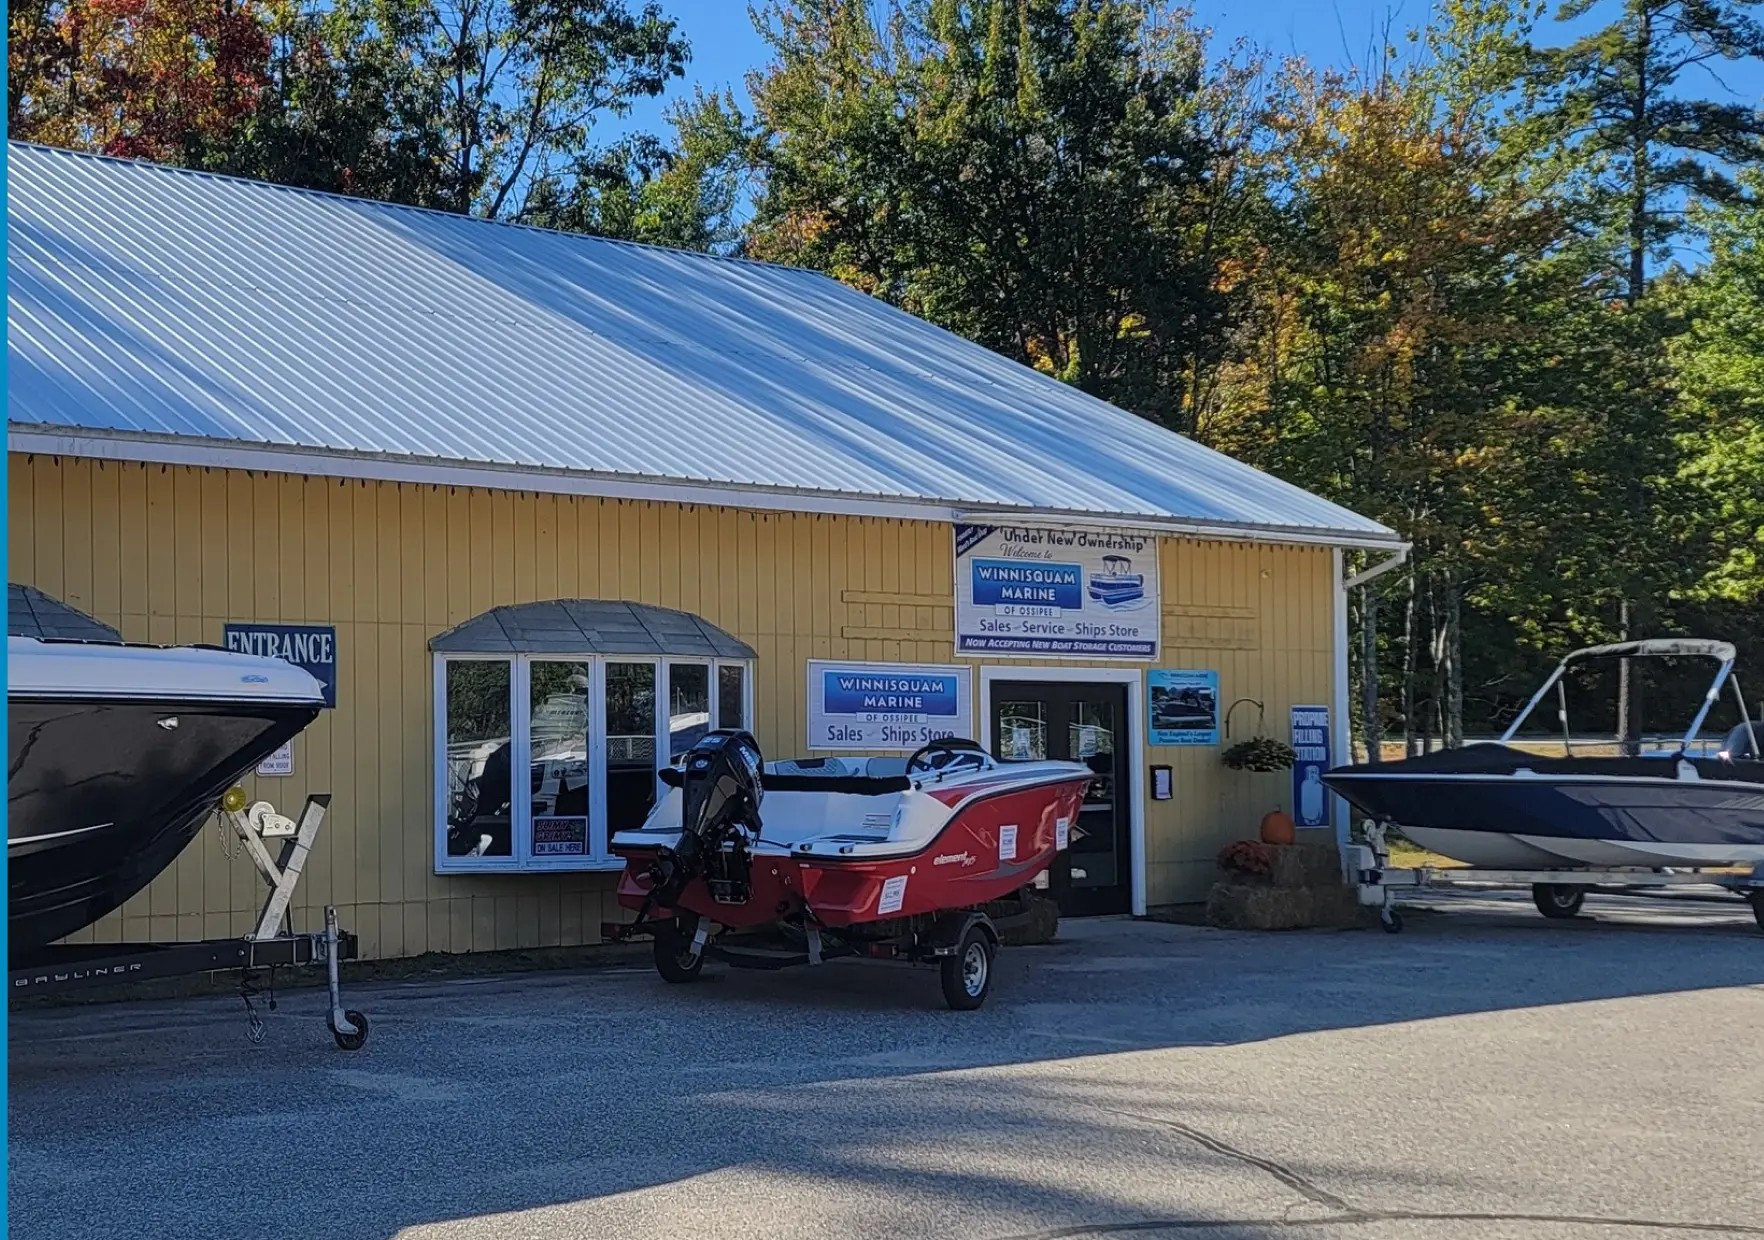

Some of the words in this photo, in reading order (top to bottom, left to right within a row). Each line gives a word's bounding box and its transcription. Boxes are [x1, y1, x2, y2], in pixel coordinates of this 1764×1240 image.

[1004, 530, 1043, 544] Under
[1048, 531, 1073, 546] New
[1078, 534, 1144, 553] Ownership
[1000, 543, 1042, 559] Welcome
[1043, 550, 1053, 559] to
[978, 566, 1076, 584] WINNISQUAM
[1001, 587, 1056, 601] MARINE
[1004, 606, 1016, 615] OF
[1019, 607, 1053, 616] OSSIPEE
[980, 619, 1011, 633] Sales
[1022, 620, 1065, 634] Service
[1075, 622, 1107, 637] Ships
[1109, 624, 1139, 637] Store
[227, 631, 333, 664] ENTRANCE
[840, 677, 944, 692] WINNISQUAM
[864, 696, 923, 708] MARINE
[882, 714, 919, 722] OSSIPEE
[1292, 711, 1329, 726] PROPANE
[827, 725, 863, 741] Sales
[881, 726, 917, 745] Ships
[1293, 729, 1323, 744] FILLING
[1296, 746, 1326, 761] STATION
[739, 746, 763, 797] MERCURY
[537, 844, 546, 852] ON
[548, 844, 563, 852] SALE
[565, 843, 581, 852] HERE
[933, 850, 968, 866] element
[15, 963, 141, 986] BAYLINER
